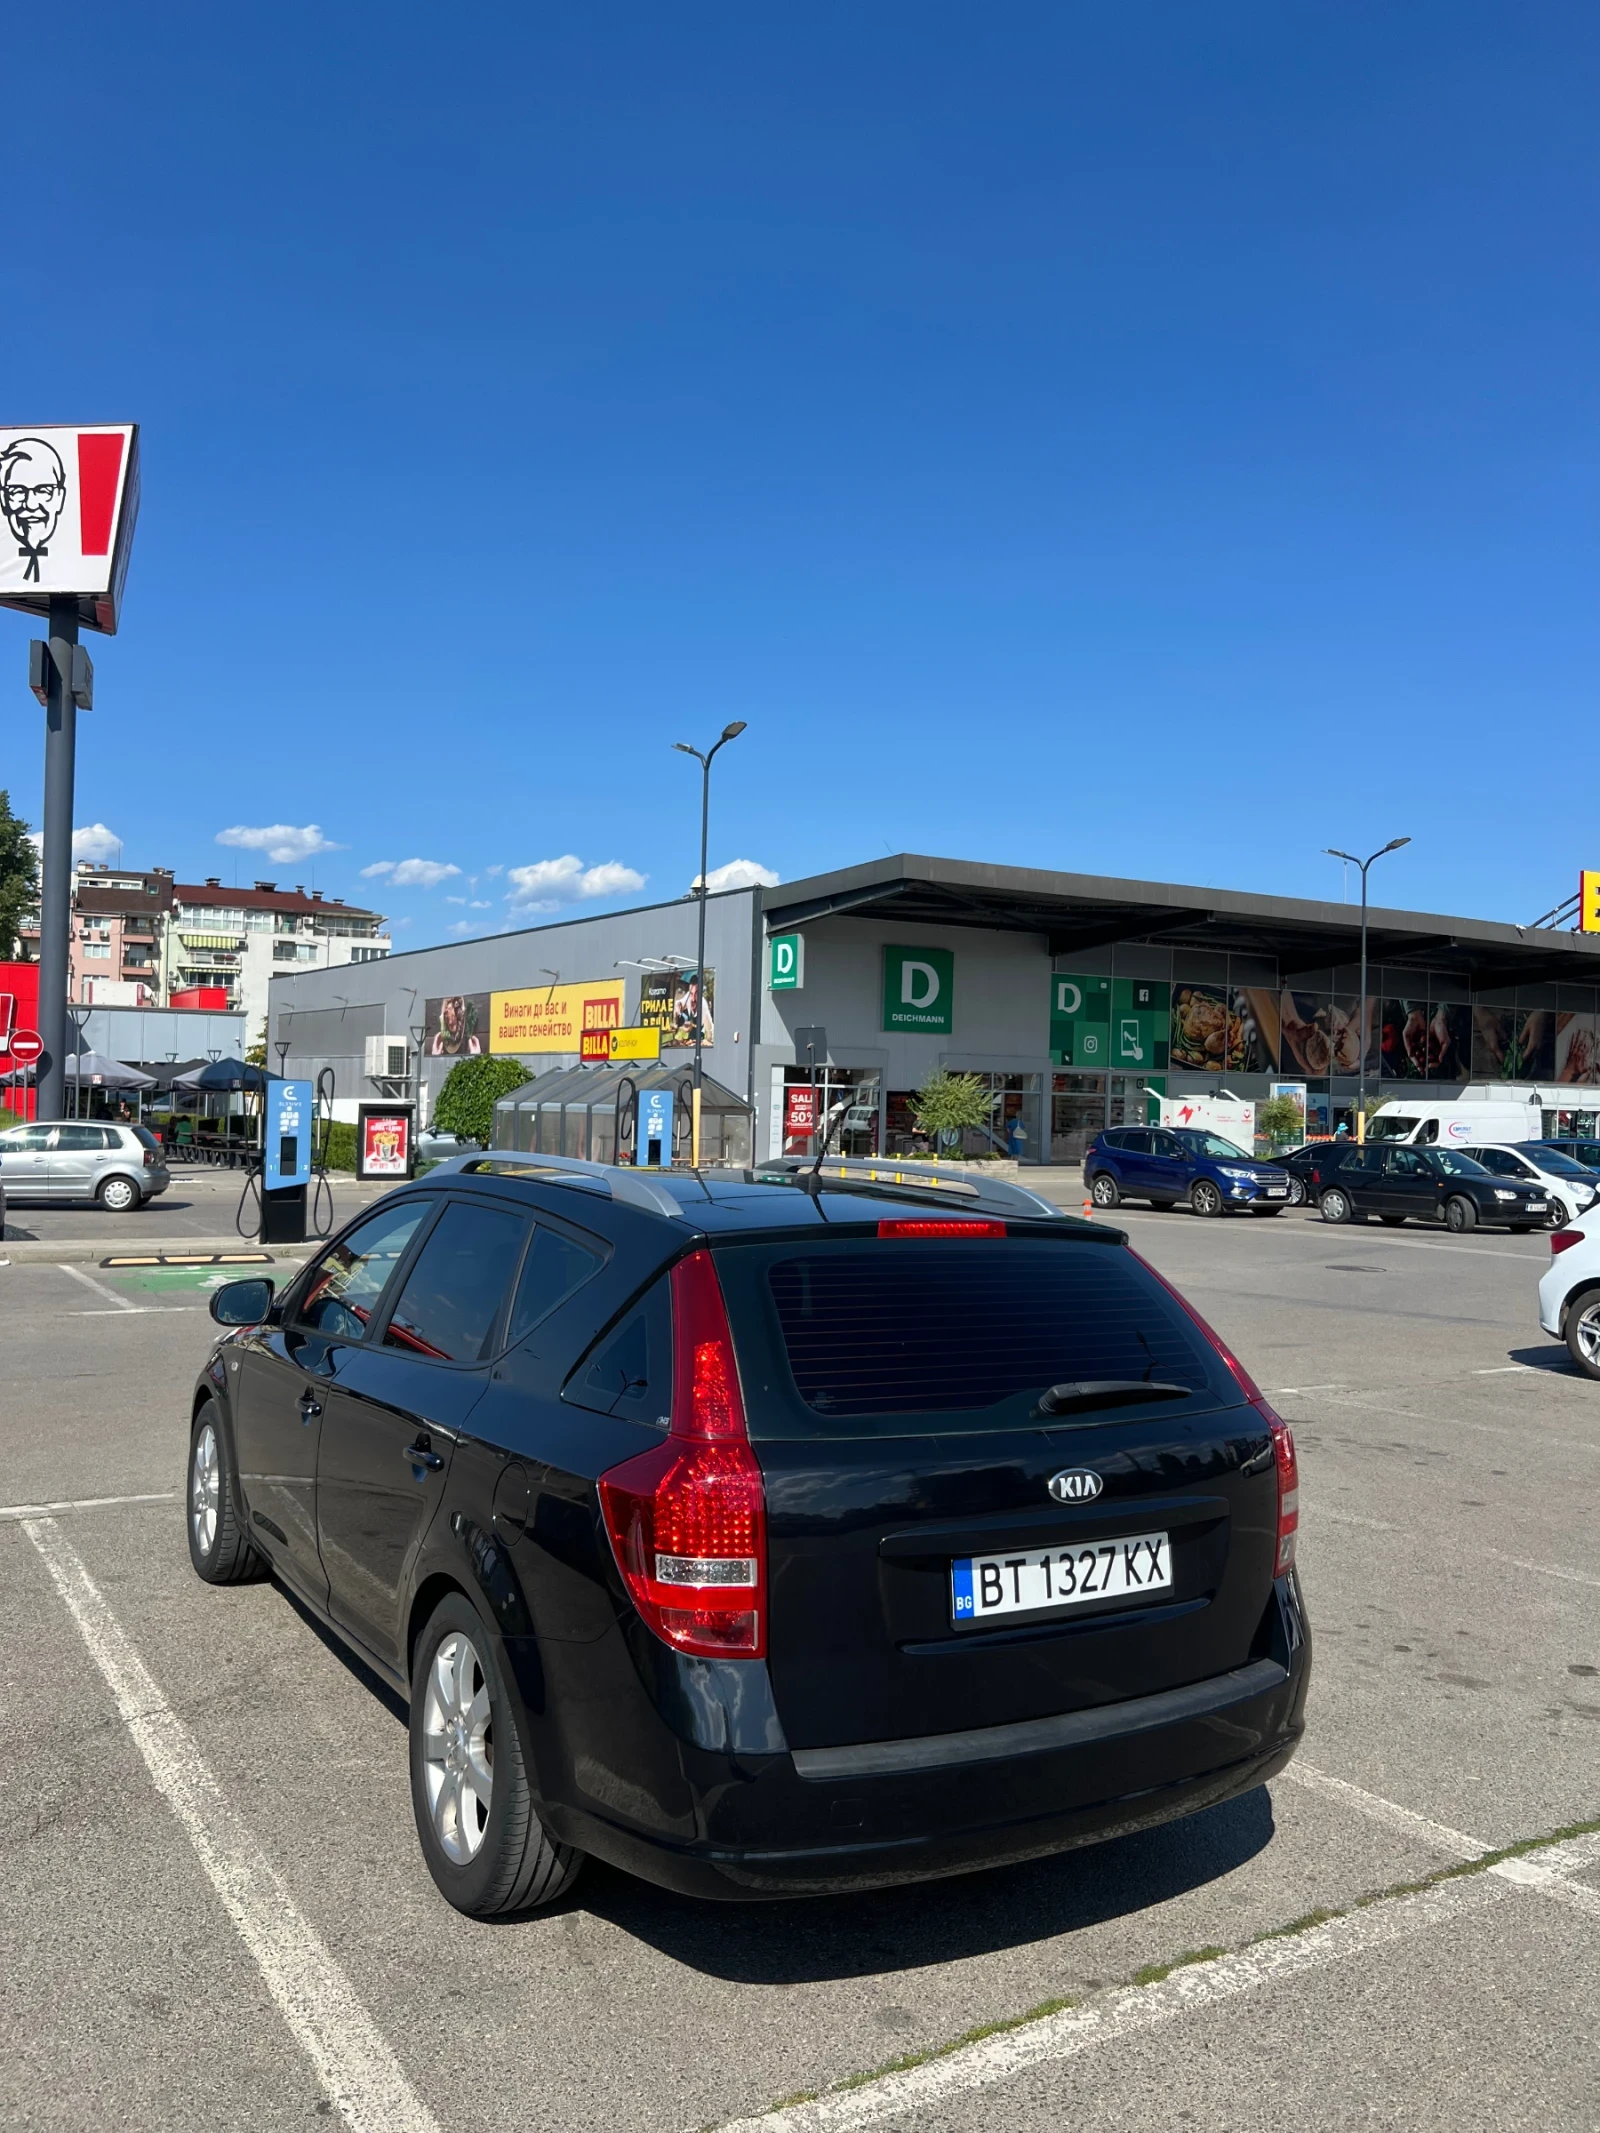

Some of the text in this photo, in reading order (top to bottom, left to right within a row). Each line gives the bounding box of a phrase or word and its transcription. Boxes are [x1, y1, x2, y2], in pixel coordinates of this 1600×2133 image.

[777, 943, 794, 974] D
[901, 960, 940, 1009] D
[1057, 982, 1082, 1014] D
[504, 1002, 567, 1019] Винаги до вас и
[585, 1003, 617, 1030] BILLA
[892, 1013, 945, 1024] DEICHMANN
[499, 1020, 572, 1039] вашето семейство
[583, 1035, 608, 1055] BILLA
[1059, 1475, 1097, 1498] KIA
[980, 1539, 1165, 1609] BT 1327 KX
[956, 1596, 972, 1611] BG
